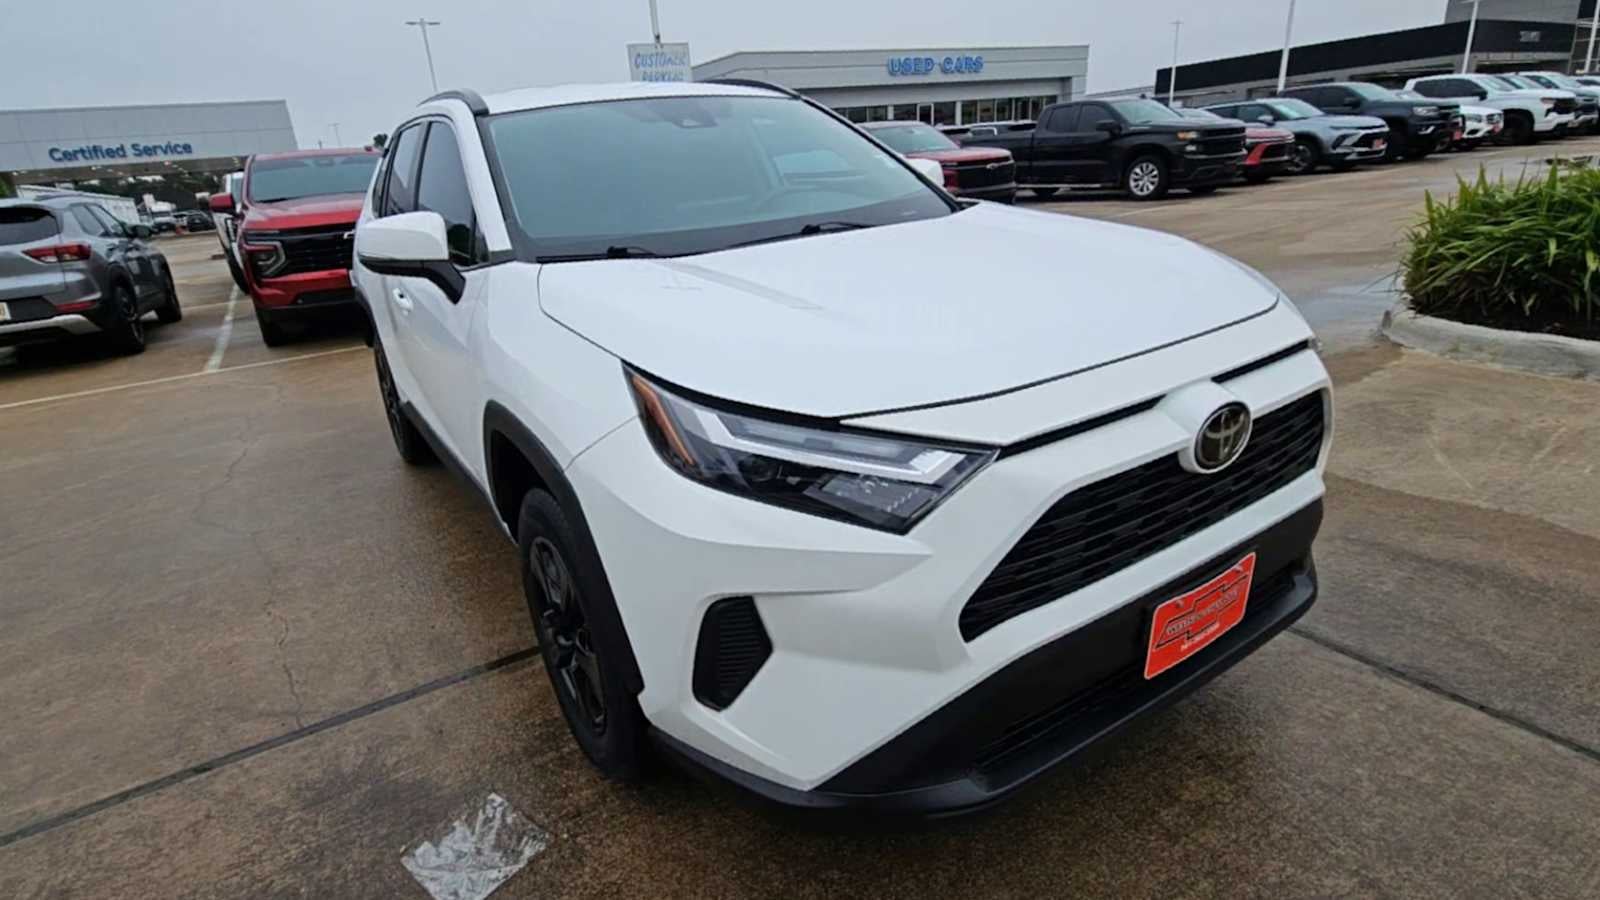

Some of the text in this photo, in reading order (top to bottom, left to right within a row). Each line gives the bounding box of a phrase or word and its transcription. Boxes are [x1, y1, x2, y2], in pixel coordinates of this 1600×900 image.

[888, 56, 983, 76] USED CARS
[48, 141, 193, 162] Certified Service
